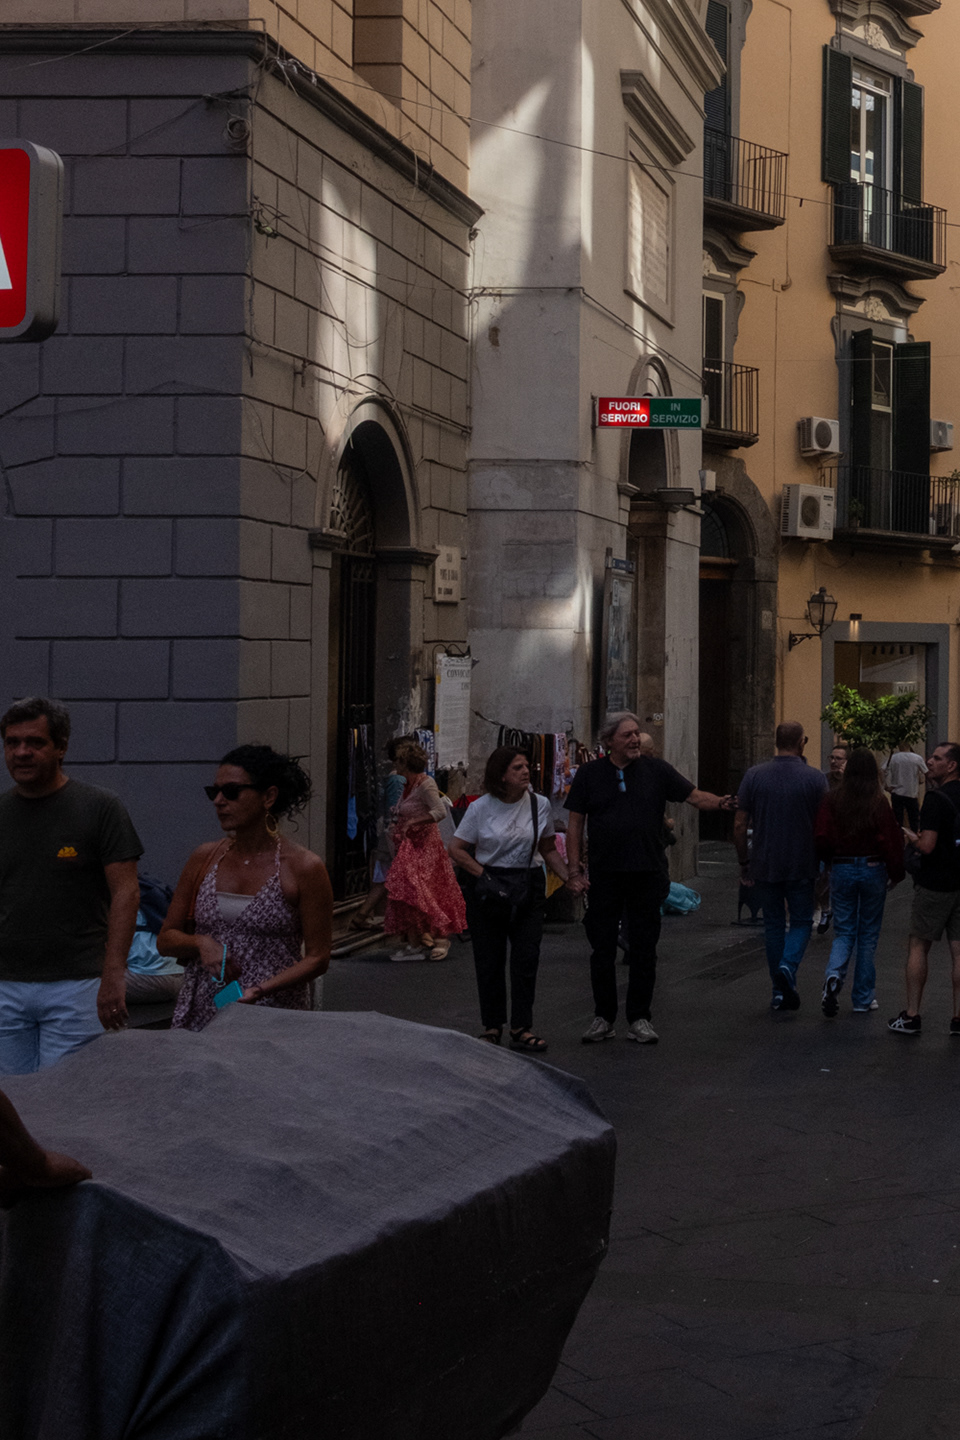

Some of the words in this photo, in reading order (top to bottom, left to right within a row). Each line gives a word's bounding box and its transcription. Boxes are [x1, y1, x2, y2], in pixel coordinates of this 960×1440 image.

[608, 401, 641, 411] FUORI
[670, 402, 681, 411] IN
[600, 413, 648, 423] SERVIZIO
[652, 415, 699, 424] SERVIZIO
